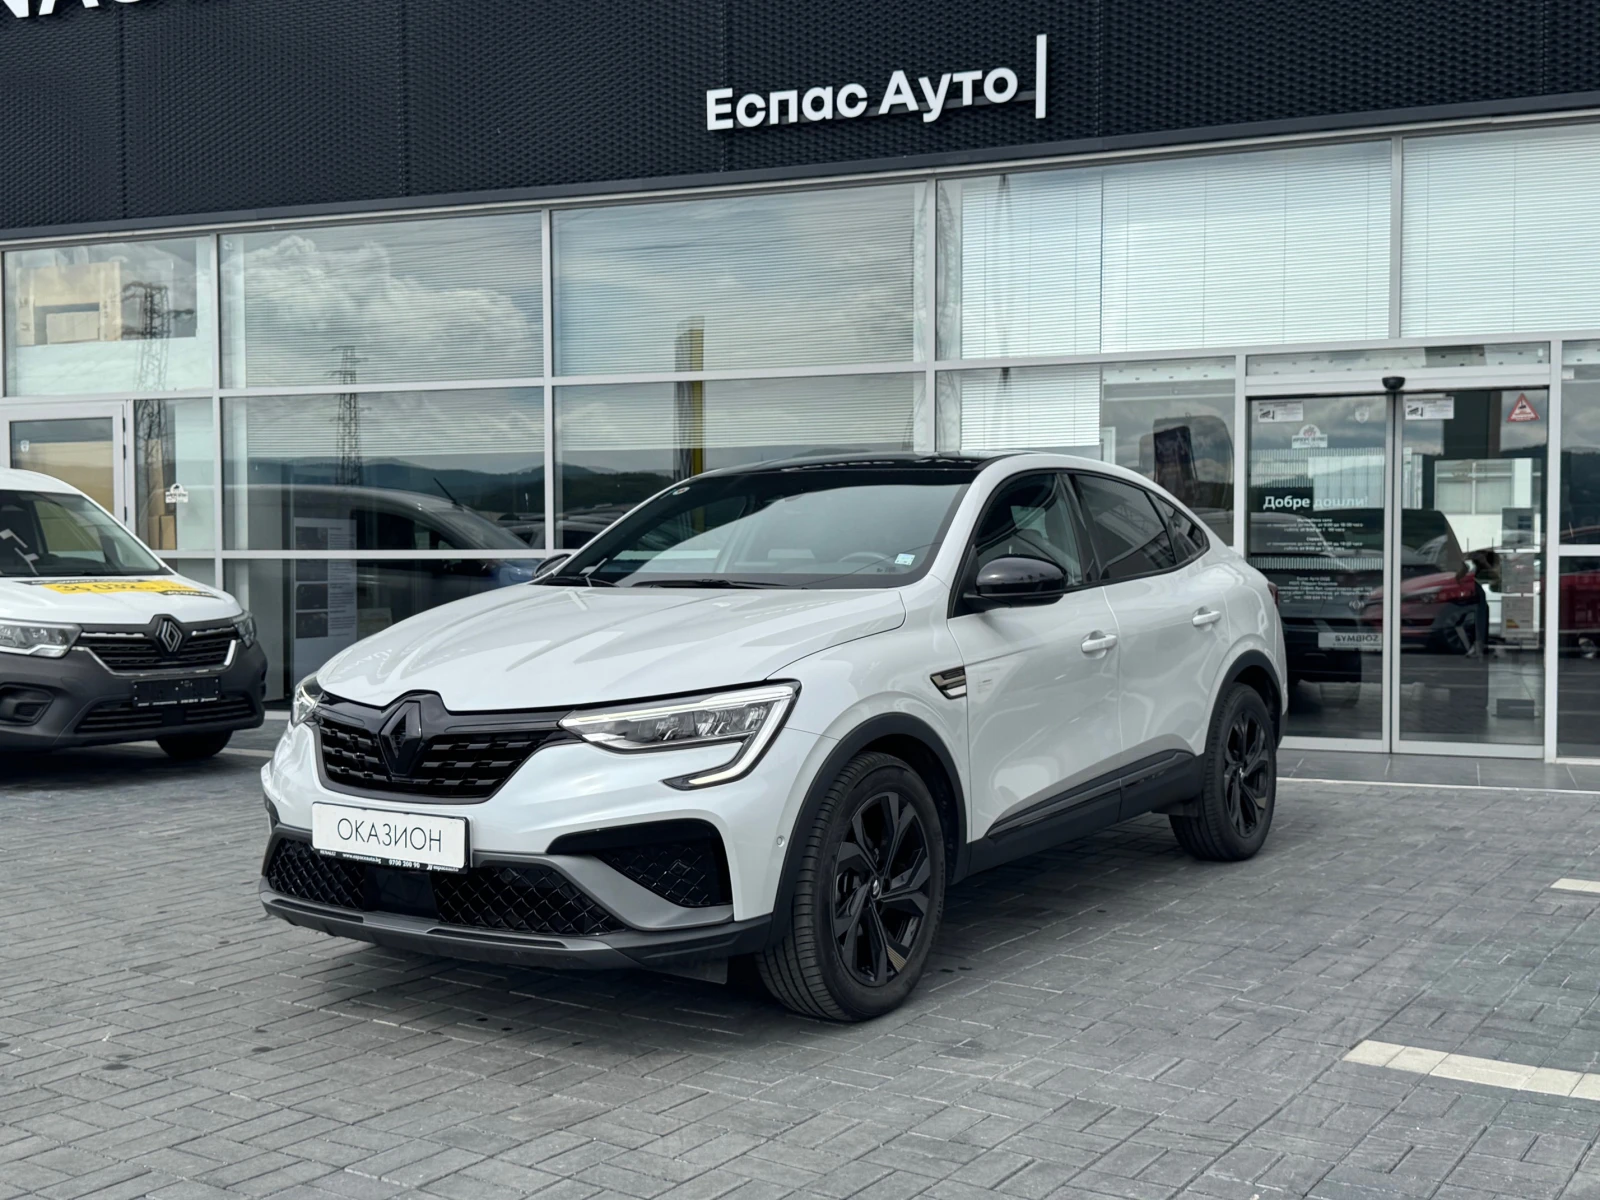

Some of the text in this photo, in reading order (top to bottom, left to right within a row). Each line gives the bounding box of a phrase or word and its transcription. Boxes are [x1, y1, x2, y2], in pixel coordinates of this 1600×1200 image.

[706, 66, 1019, 131] Еспас Ауто
[1263, 495, 1311, 510] Добре
[1335, 634, 1379, 642] SYMBIOZ
[337, 818, 442, 853] ОКАЗИОН
[388, 859, 402, 867] 0700
[403, 860, 413, 868] 200
